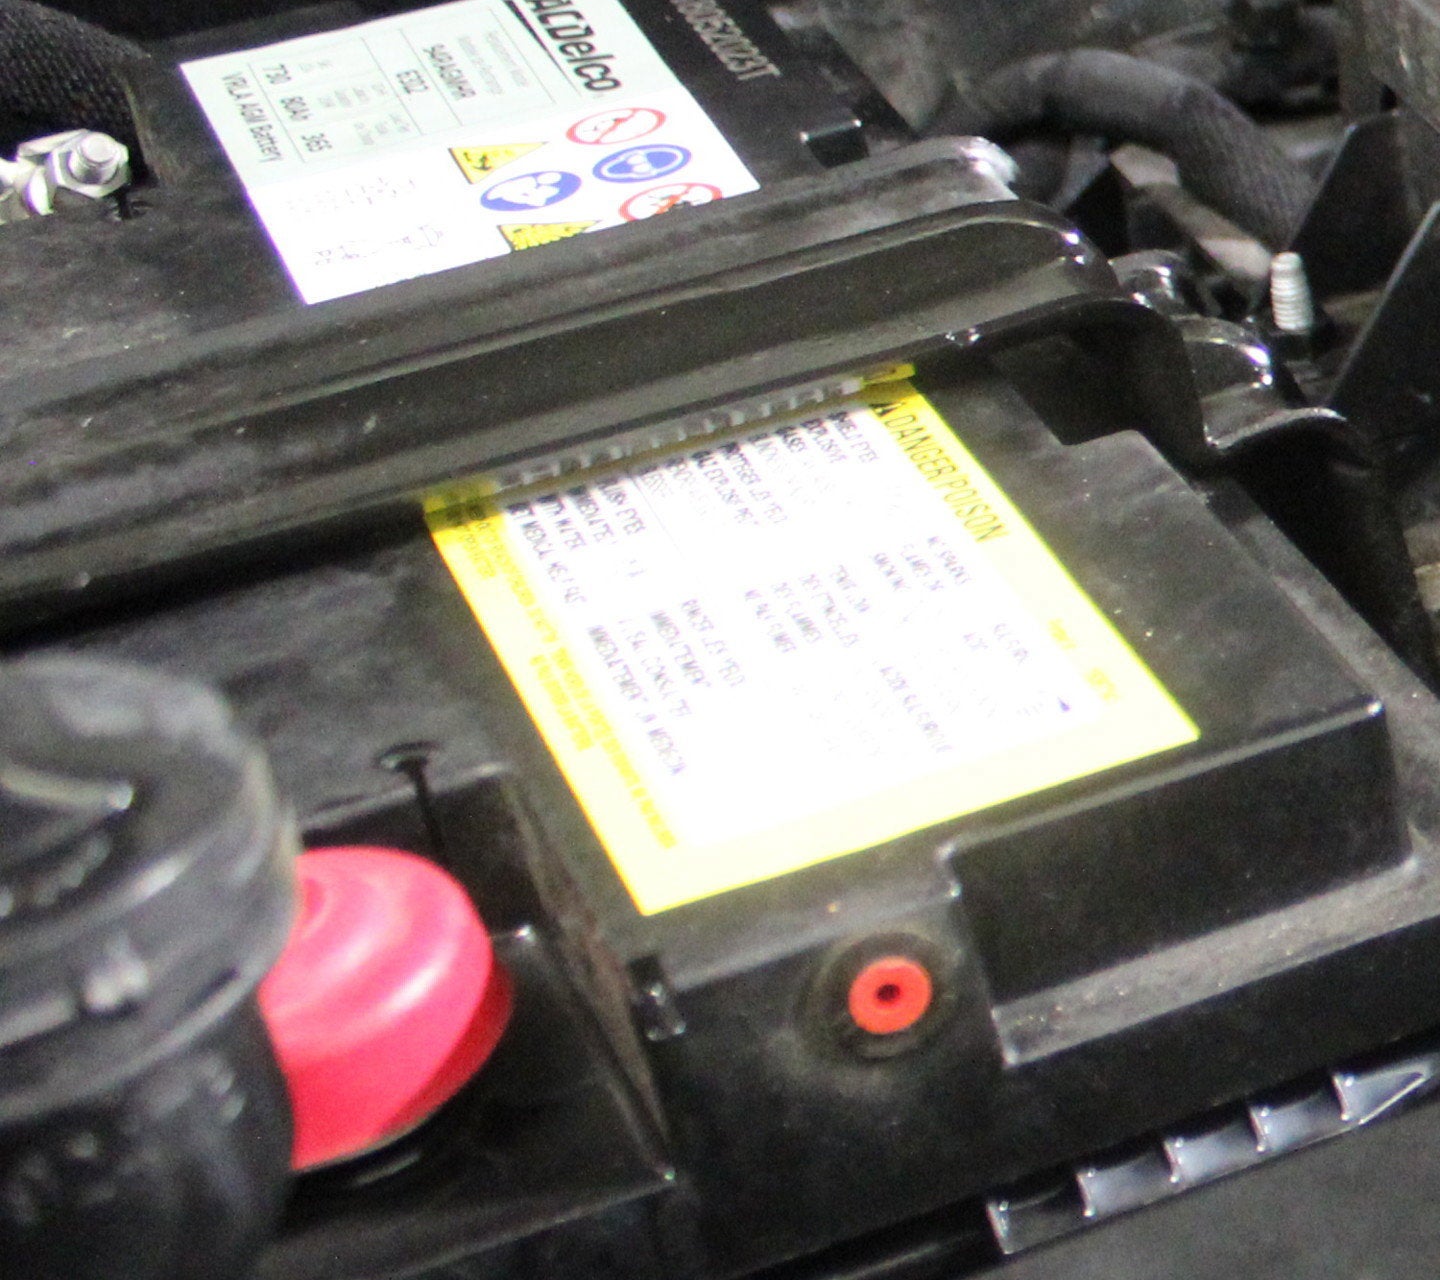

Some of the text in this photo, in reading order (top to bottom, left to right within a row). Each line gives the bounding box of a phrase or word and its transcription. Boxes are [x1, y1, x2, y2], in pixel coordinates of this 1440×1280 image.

[222, 70, 283, 163] VRLA AGM Battery
